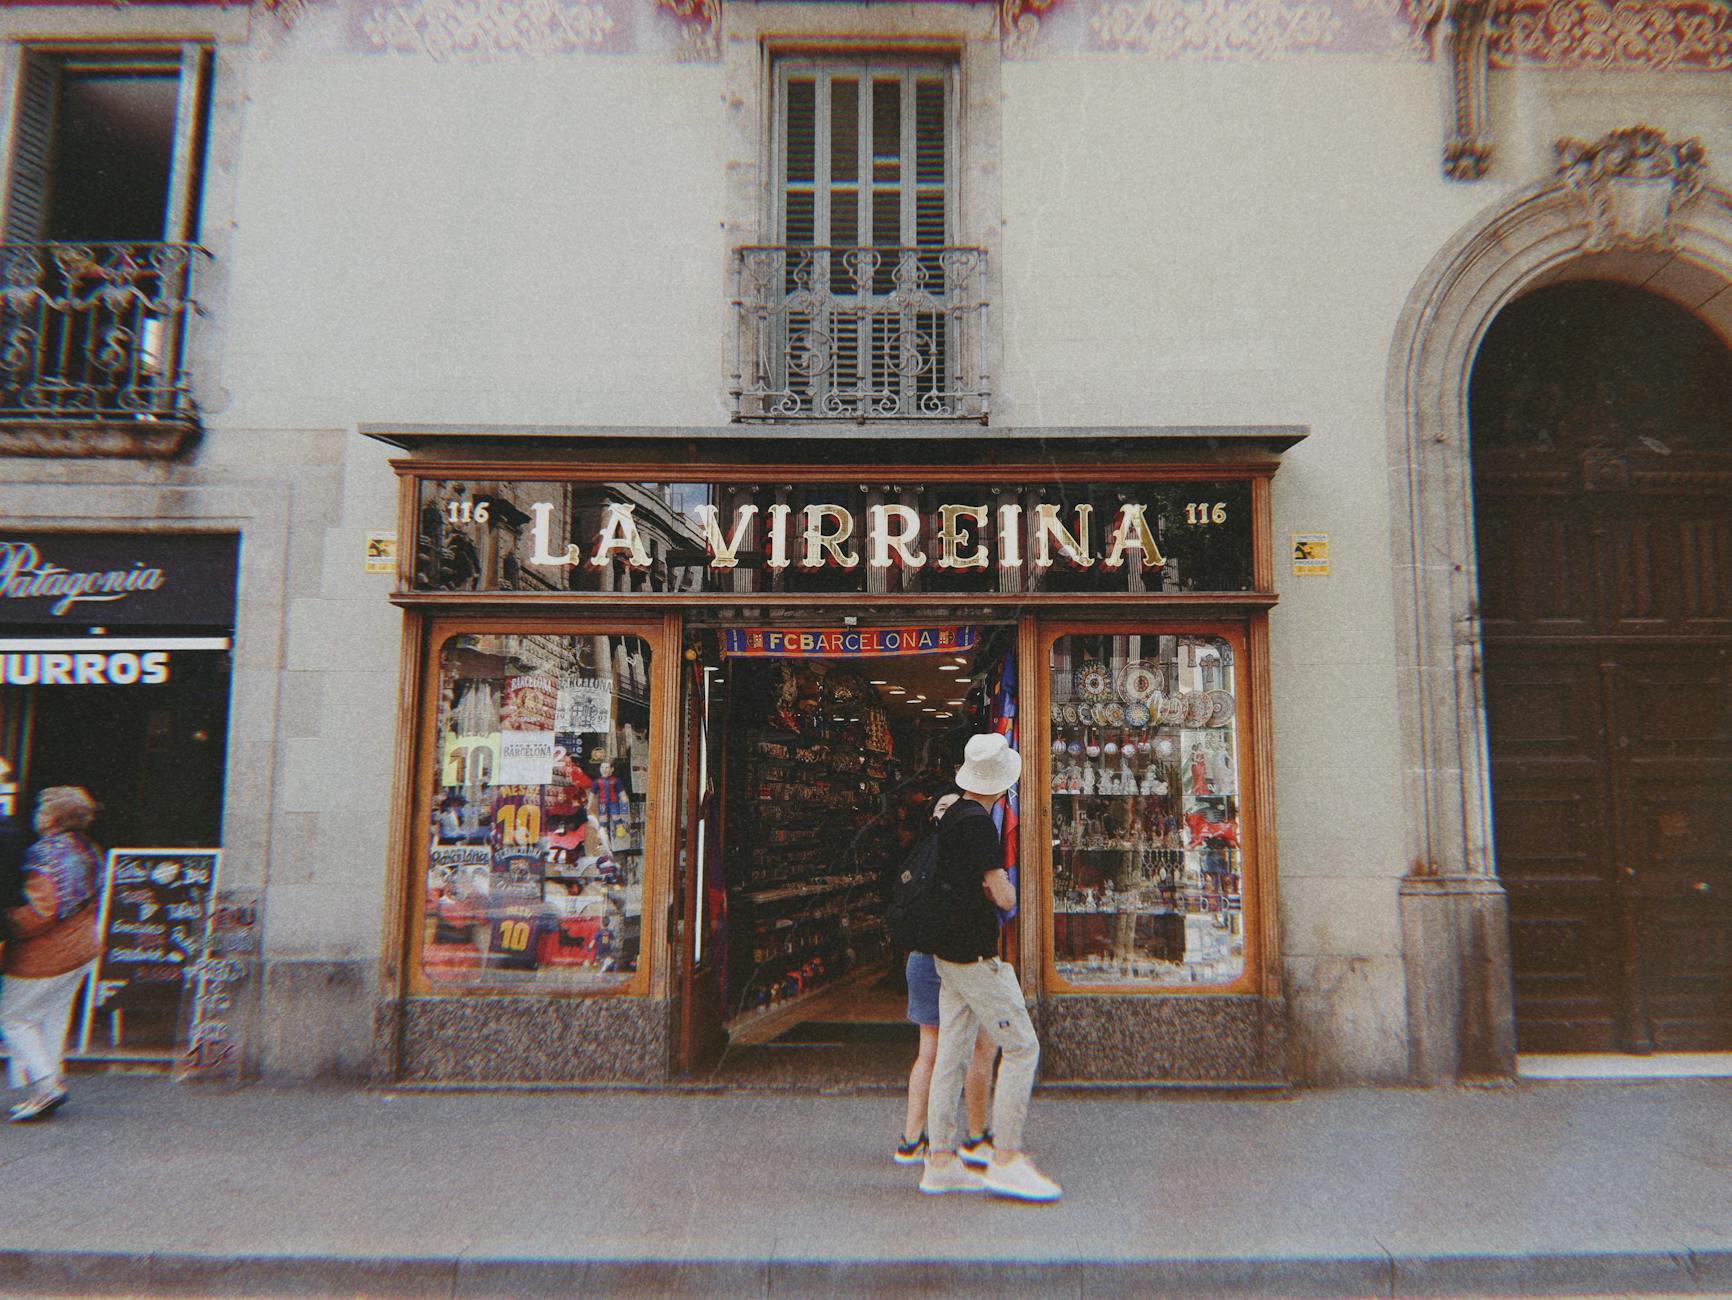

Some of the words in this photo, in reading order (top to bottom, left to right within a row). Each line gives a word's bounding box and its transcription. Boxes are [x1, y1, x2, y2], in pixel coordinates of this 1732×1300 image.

[448, 501, 490, 524] 116
[1185, 502, 1228, 524] 116
[530, 502, 653, 567] LA
[694, 503, 1168, 568] VIRREINA
[0, 541, 167, 616] Patagonia
[0, 652, 170, 685] URROS
[448, 745, 493, 785] 10
[503, 746, 552, 758] BARCELONA
[496, 804, 541, 845] 10
[500, 919, 530, 952] 10
